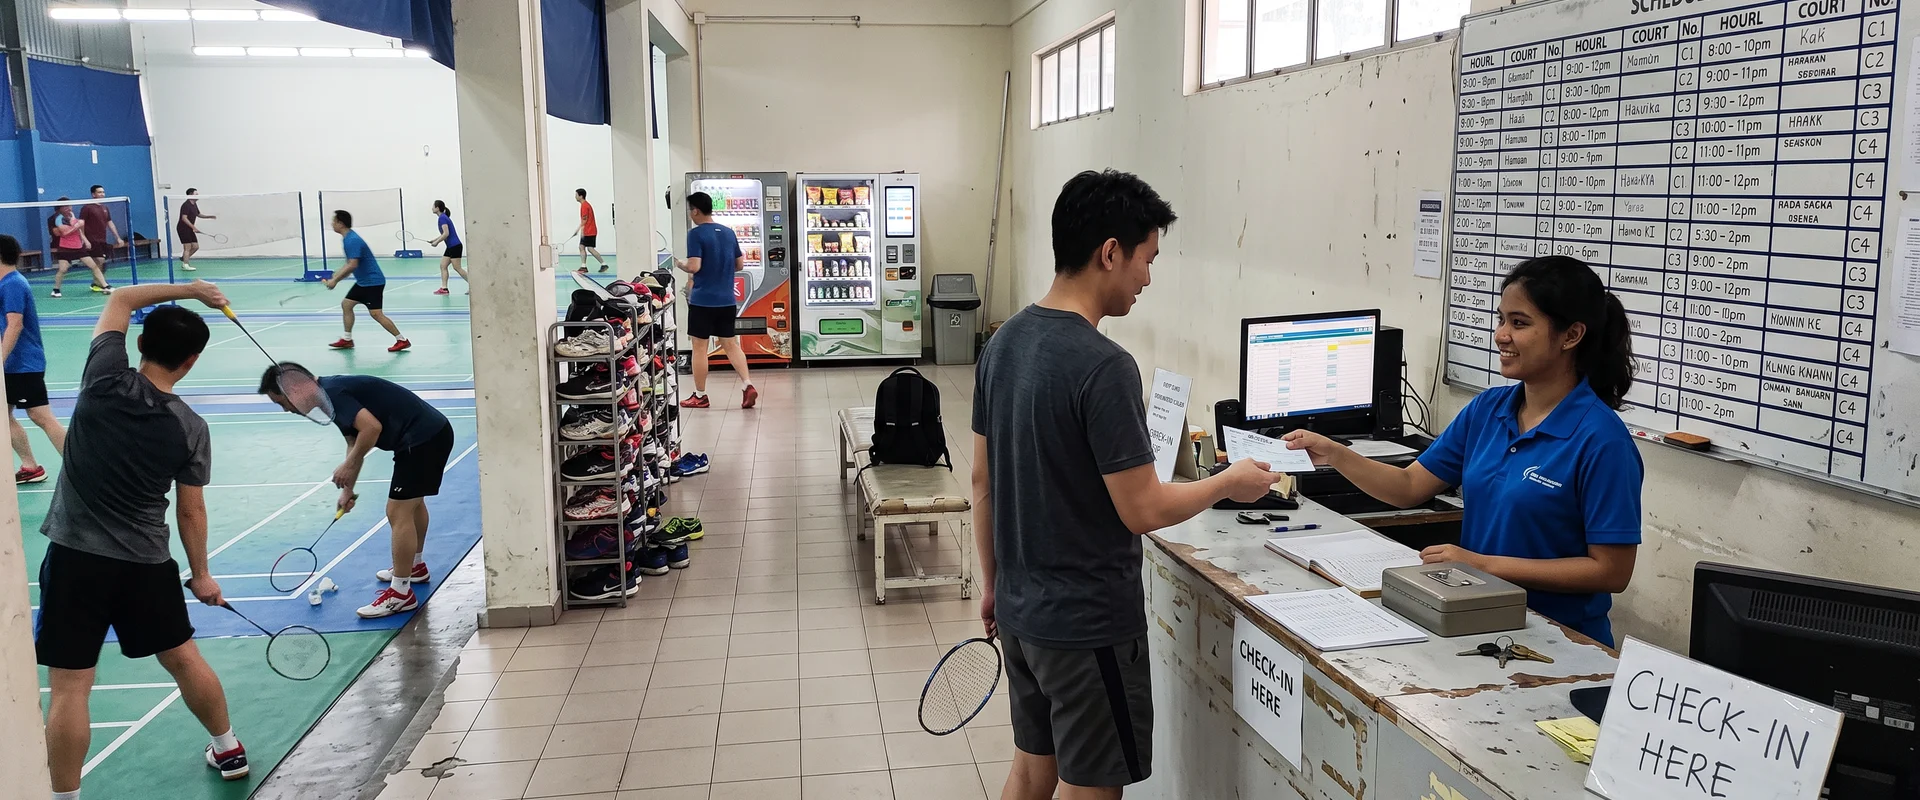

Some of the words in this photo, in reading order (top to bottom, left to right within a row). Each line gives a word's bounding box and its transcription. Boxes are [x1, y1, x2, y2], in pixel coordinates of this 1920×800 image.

[1631, 0, 1704, 15] SCHE
[1799, 0, 1847, 18] COURT
[1720, 11, 1763, 30] HOURL
[1632, 26, 1669, 43] COURT
[1682, 22, 1699, 36] No.
[1867, 20, 1885, 37] C1
[1548, 45, 1561, 56] No.
[1575, 36, 1607, 52] HOURL
[1708, 42, 1731, 57] 8:00
[1744, 39, 1771, 55] 10pm
[1511, 48, 1538, 62] COURT
[1681, 47, 1694, 60] C1
[1864, 52, 1884, 68] C2
[1470, 55, 1494, 69] HOURL
[1566, 62, 1583, 75] 9:00
[1591, 60, 1611, 74] 12pm
[1547, 65, 1557, 77] C1
[1707, 69, 1730, 83] 9:00
[1742, 67, 1767, 82] 11pm
[1679, 72, 1692, 86] C2
[1546, 88, 1556, 101] C1
[1565, 85, 1583, 97] 8:00
[1590, 84, 1611, 97] 10pm
[1862, 83, 1881, 99] C3
[1677, 98, 1691, 112] C3
[1704, 96, 1726, 110] 9:30
[1738, 94, 1764, 109] 12pm
[1544, 110, 1555, 122] C2
[1563, 108, 1581, 120] 8:00
[1589, 107, 1609, 121] 12pm
[1860, 111, 1879, 126] C3
[1480, 116, 1494, 128] 9pm
[1676, 122, 1689, 136] C3
[1701, 121, 1726, 133] 10:00
[1737, 119, 1762, 134] 11pm
[1480, 137, 1493, 149] 9pm
[1543, 132, 1553, 144] C3
[1562, 130, 1579, 142] 8:00
[1587, 129, 1606, 143] 11pm
[1675, 146, 1688, 159] C2
[1700, 145, 1724, 157] 11:00
[1736, 144, 1760, 160] 11pm
[1858, 139, 1877, 154] C4
[1478, 157, 1493, 168] 9pm
[1542, 153, 1551, 164] C1
[1561, 152, 1578, 163] 9:00
[1559, 176, 1578, 186] 11:00
[1585, 176, 1606, 190] 10pm
[1698, 175, 1722, 187] 11:00
[1734, 174, 1759, 190] 12pm
[1855, 173, 1875, 189] C4
[1476, 198, 1492, 211] 12pm
[1540, 200, 1551, 211] C2
[1559, 200, 1575, 211] 9:00
[1584, 200, 1604, 214] 12pm
[1672, 202, 1684, 215] C2
[1697, 203, 1720, 215] 11:00
[1731, 203, 1757, 219] 12pm
[1778, 201, 1801, 209] RADA
[1853, 205, 1873, 221] C4
[1475, 219, 1491, 231] 12pm
[1539, 221, 1549, 232] C2
[1583, 224, 1602, 238] 12pm
[1645, 226, 1655, 238] KI
[1670, 228, 1682, 241] C2
[1695, 229, 1717, 241] 5:30
[1728, 230, 1750, 246] 2pm
[1475, 239, 1489, 251] 2pm
[1538, 243, 1548, 254] C2
[1851, 238, 1870, 253] C4
[1557, 245, 1574, 256] 9:00
[1582, 246, 1599, 260] 6pm
[1668, 253, 1681, 266] C3
[1474, 258, 1488, 270] 2pm
[1693, 255, 1715, 267] 9:00
[1726, 257, 1748, 273] 2pm
[1849, 267, 1866, 282] C3
[1667, 277, 1680, 290] C3
[1691, 279, 1713, 292] 9:00
[1724, 283, 1750, 299] 12pm
[1472, 295, 1486, 307] 2pm
[1666, 300, 1679, 312] C4
[1846, 295, 1864, 310] C3
[1690, 304, 1711, 316] 11:00
[1664, 322, 1677, 335] C3
[1808, 318, 1821, 330] KE
[1845, 322, 1863, 336] C4
[1687, 326, 1710, 339] 11:00
[1720, 330, 1742, 345] 2pm
[1663, 344, 1676, 357] C3
[1843, 348, 1860, 362] C4
[1686, 349, 1710, 362] 11:00
[1721, 354, 1749, 369] 10pm
[1662, 367, 1674, 380] C3
[1840, 373, 1858, 388] C4
[1684, 372, 1706, 386] 9:30
[1715, 378, 1737, 392] 5pm
[1660, 393, 1671, 405] C1
[1783, 399, 1803, 409] SANN
[1681, 397, 1704, 411] 11:00
[1713, 404, 1735, 418] 2pm
[1838, 400, 1856, 415] C4
[1836, 430, 1854, 444] C4
[1239, 640, 1293, 696] CHECK-IN
[1251, 677, 1281, 718] HERE
[1627, 670, 1810, 769] CHECK-IN
[1639, 732, 1736, 798] HERE
